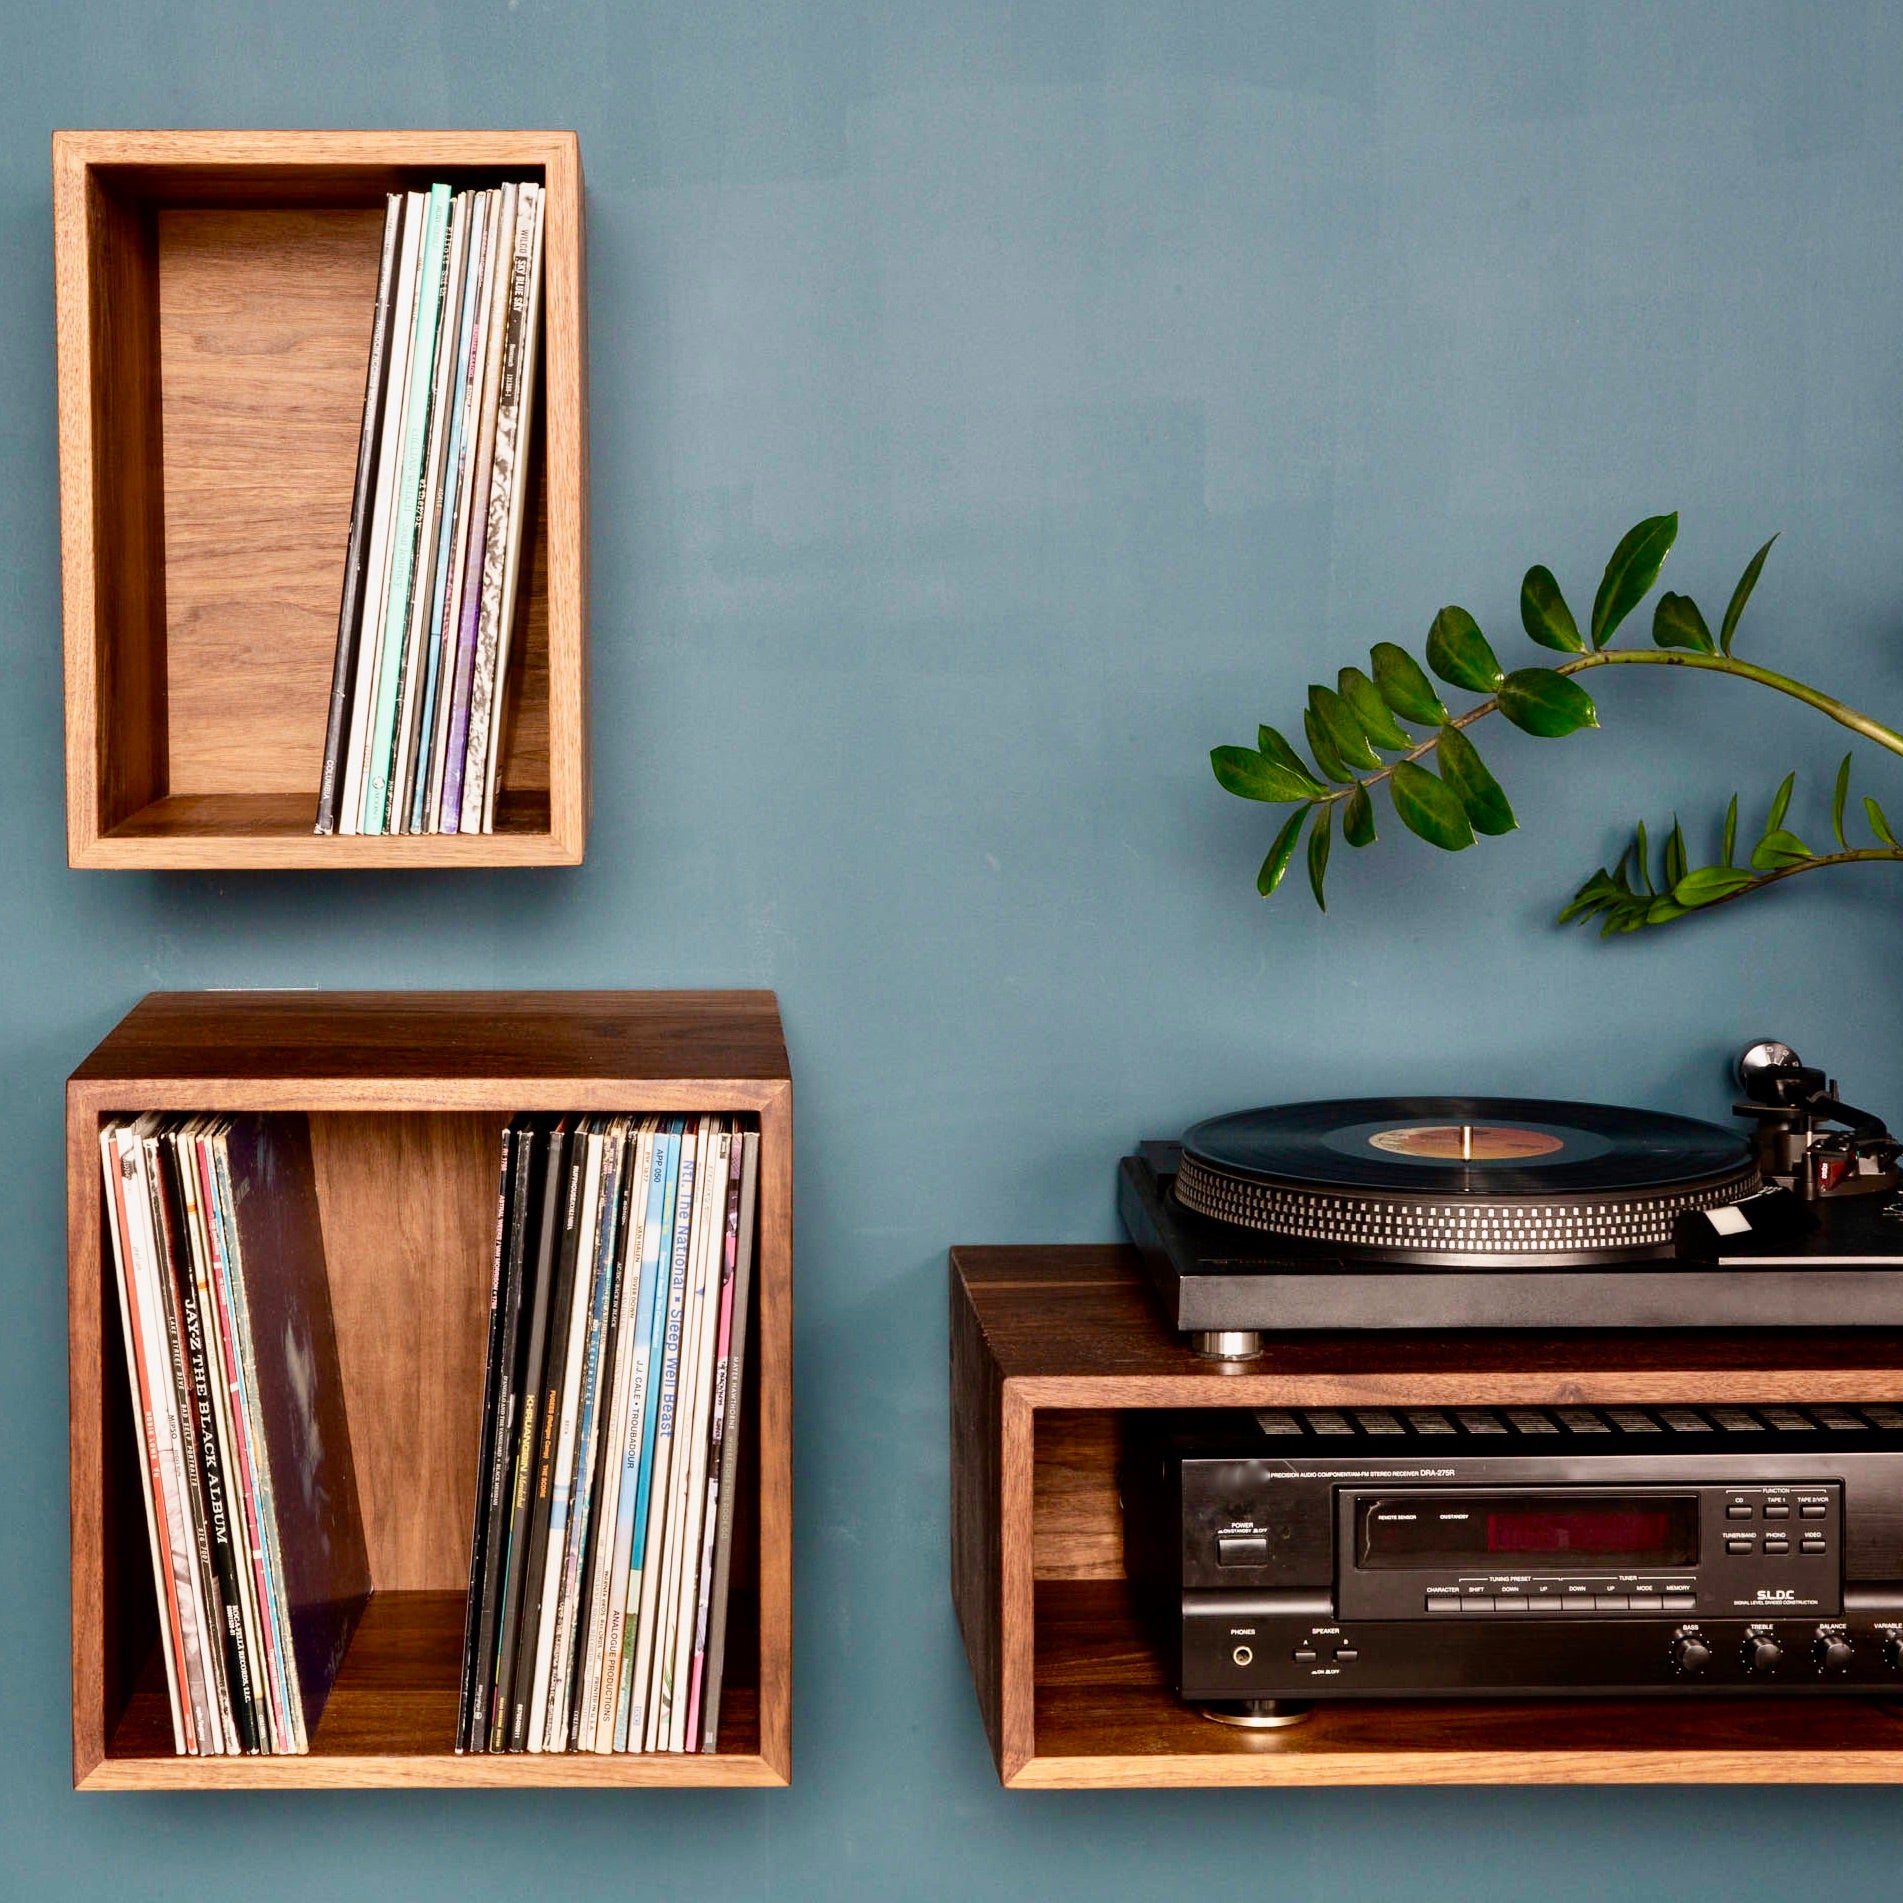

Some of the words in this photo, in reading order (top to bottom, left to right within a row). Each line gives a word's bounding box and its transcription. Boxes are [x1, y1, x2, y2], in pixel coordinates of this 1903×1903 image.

[519, 229, 528, 254] WILCO
[514, 276, 525, 296] BLUE
[517, 259, 526, 275] SKY
[513, 297, 523, 312] SKY
[408, 428, 420, 471] GILLIAN
[403, 475, 414, 512] WELCH
[415, 479, 426, 528] either/or
[394, 549, 408, 589] Journey
[323, 760, 334, 799] COLUMBIA
[654, 1168, 662, 1183] 050
[655, 1149, 663, 1166] APP
[681, 1160, 695, 1188] Ntl.
[679, 1193, 693, 1219] The
[673, 1226, 688, 1290] National
[185, 1300, 201, 1350] JAY-Z
[666, 1309, 684, 1351] Sleep
[172, 1340, 181, 1367] STREET
[665, 1358, 678, 1387] Well
[176, 1372, 184, 1390] DIVE
[192, 1355, 206, 1396] THE
[634, 1377, 642, 1399] CALE
[660, 1394, 674, 1437] Beast
[728, 1382, 737, 1430] HAWTHORNE
[168, 1415, 177, 1439] MIPSO
[199, 1401, 216, 1468] BLACK
[520, 1395, 535, 1472] KHRUANGBIN
[627, 1408, 639, 1469] TROUBADOUR
[187, 1446, 197, 1487] PORTRAITS
[541, 1464, 549, 1475] THE
[540, 1476, 548, 1498] SCORE
[208, 1472, 227, 1544] ALBUM
[609, 1610, 619, 1658] ANALOGUE
[603, 1660, 616, 1722] PRODUCTIONS
